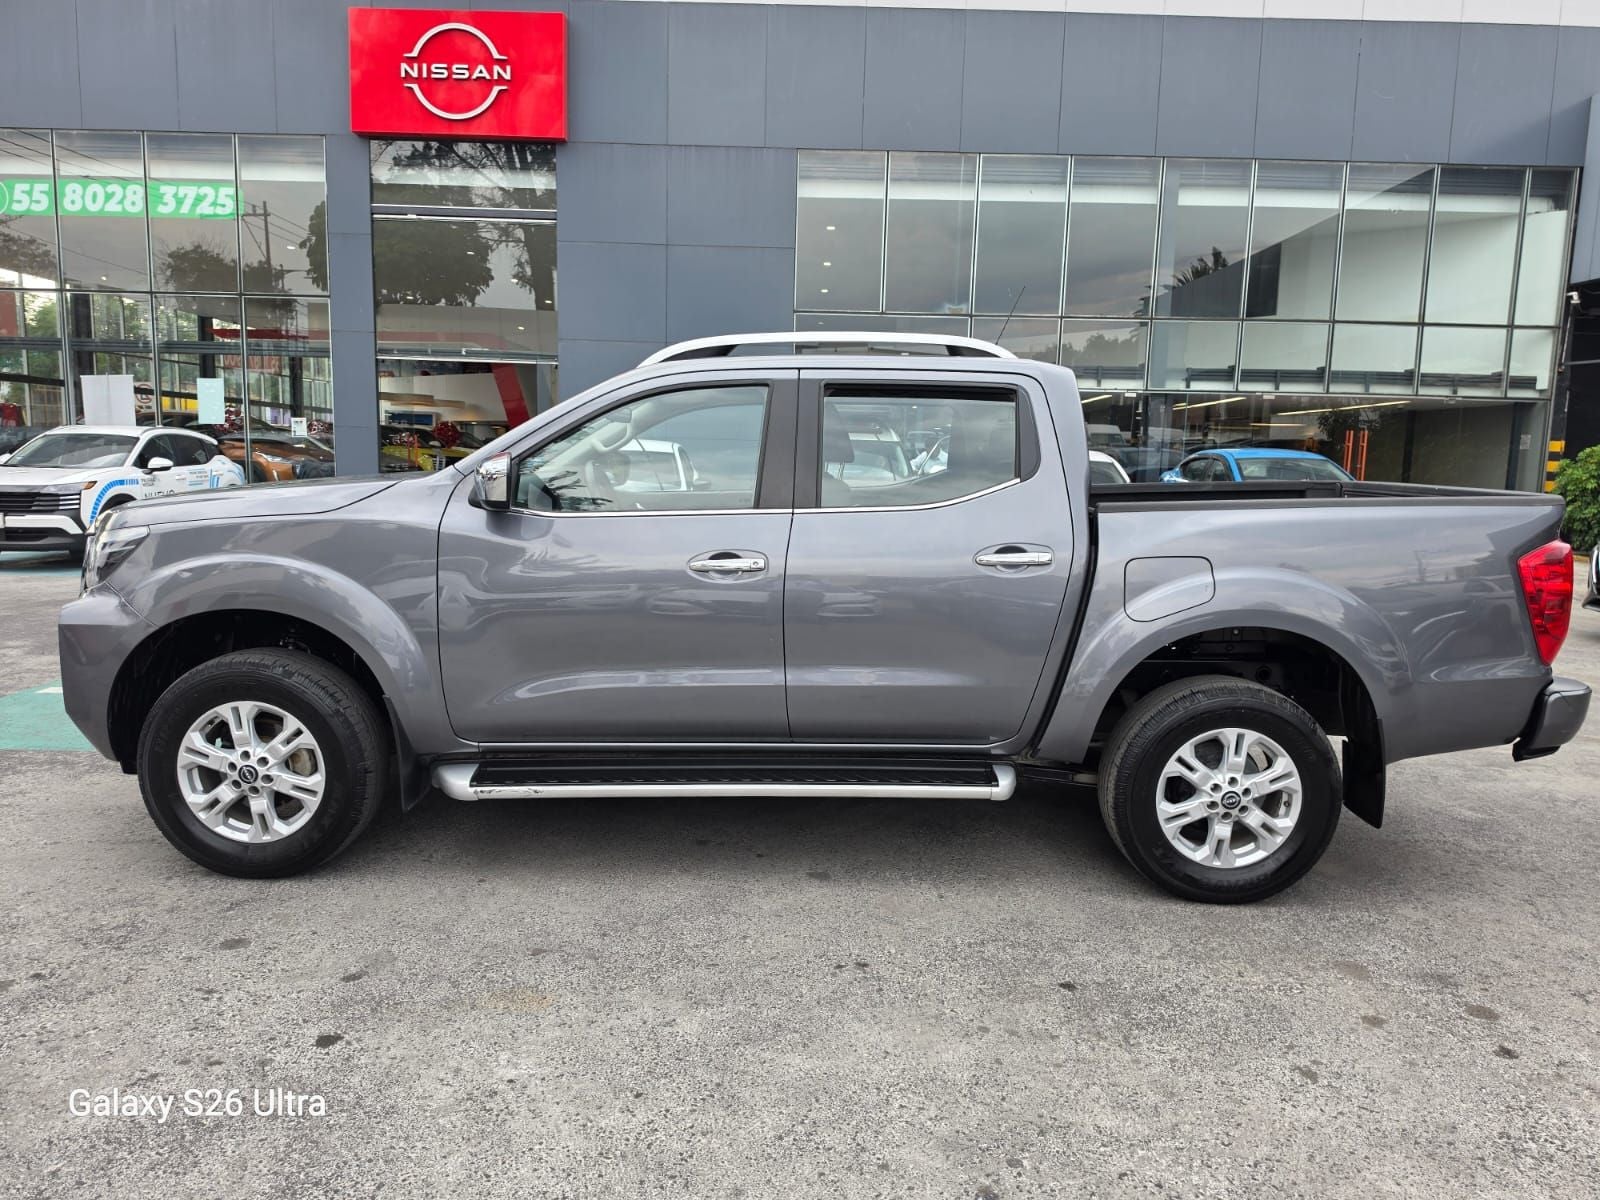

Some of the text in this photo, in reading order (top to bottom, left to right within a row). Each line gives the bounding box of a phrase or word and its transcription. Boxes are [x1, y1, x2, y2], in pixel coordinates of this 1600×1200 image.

[400, 62, 512, 80] NISSAN
[11, 183, 235, 215] 55 8028 3725
